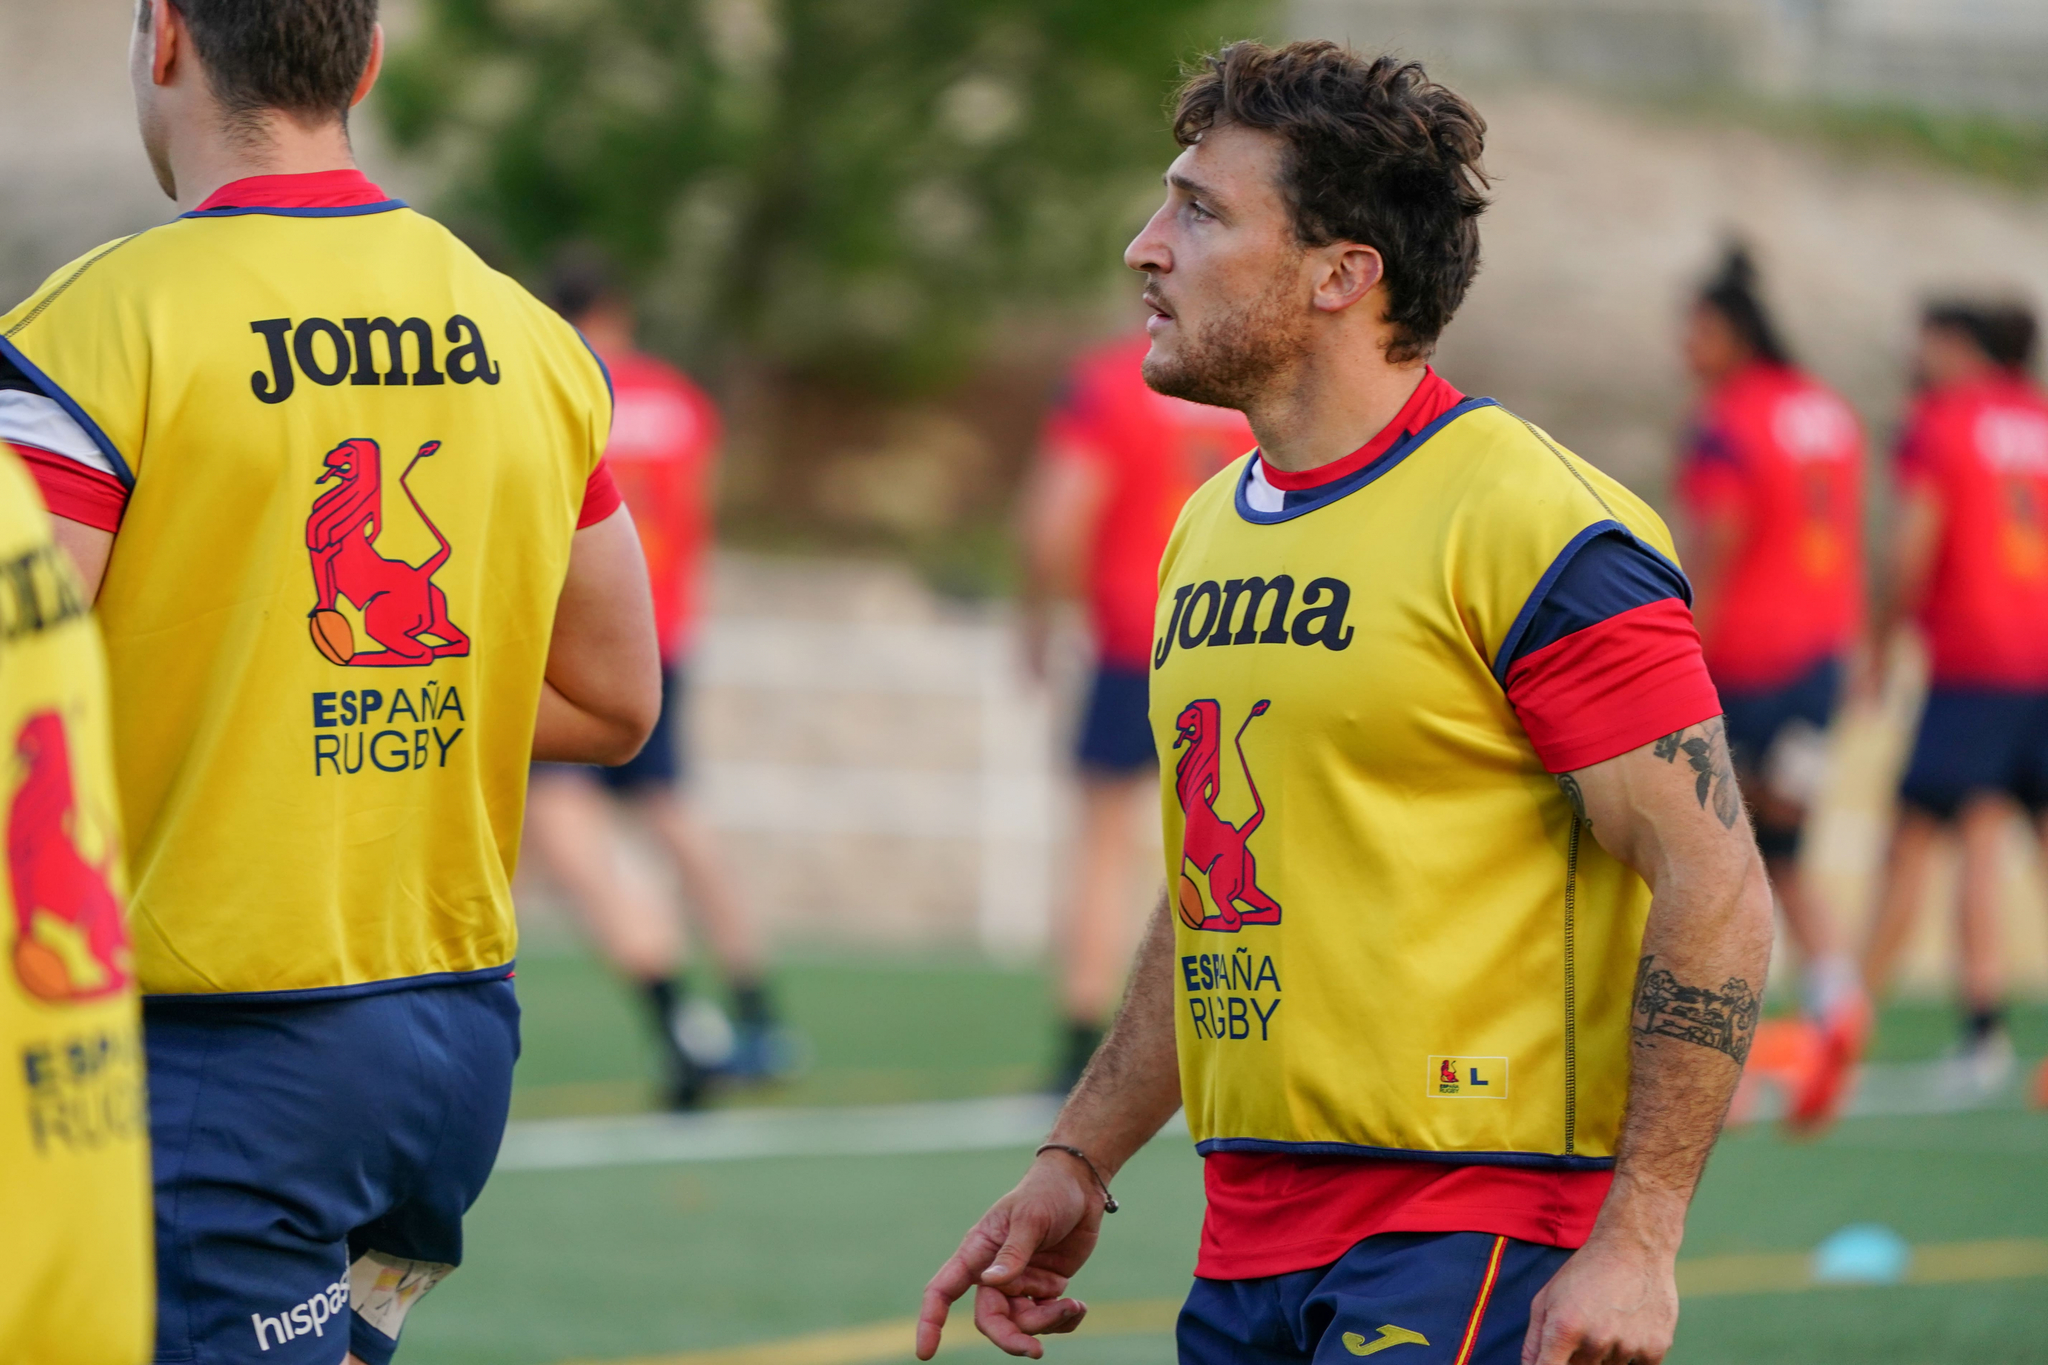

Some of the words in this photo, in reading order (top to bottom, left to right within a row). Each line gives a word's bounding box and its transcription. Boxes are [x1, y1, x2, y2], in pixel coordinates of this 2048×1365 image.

[312, 679, 466, 728] ESPAÑA
[314, 726, 465, 777] RUGBY
[1181, 946, 1282, 992] ESPAÑA
[1470, 1068, 1489, 1085] L
